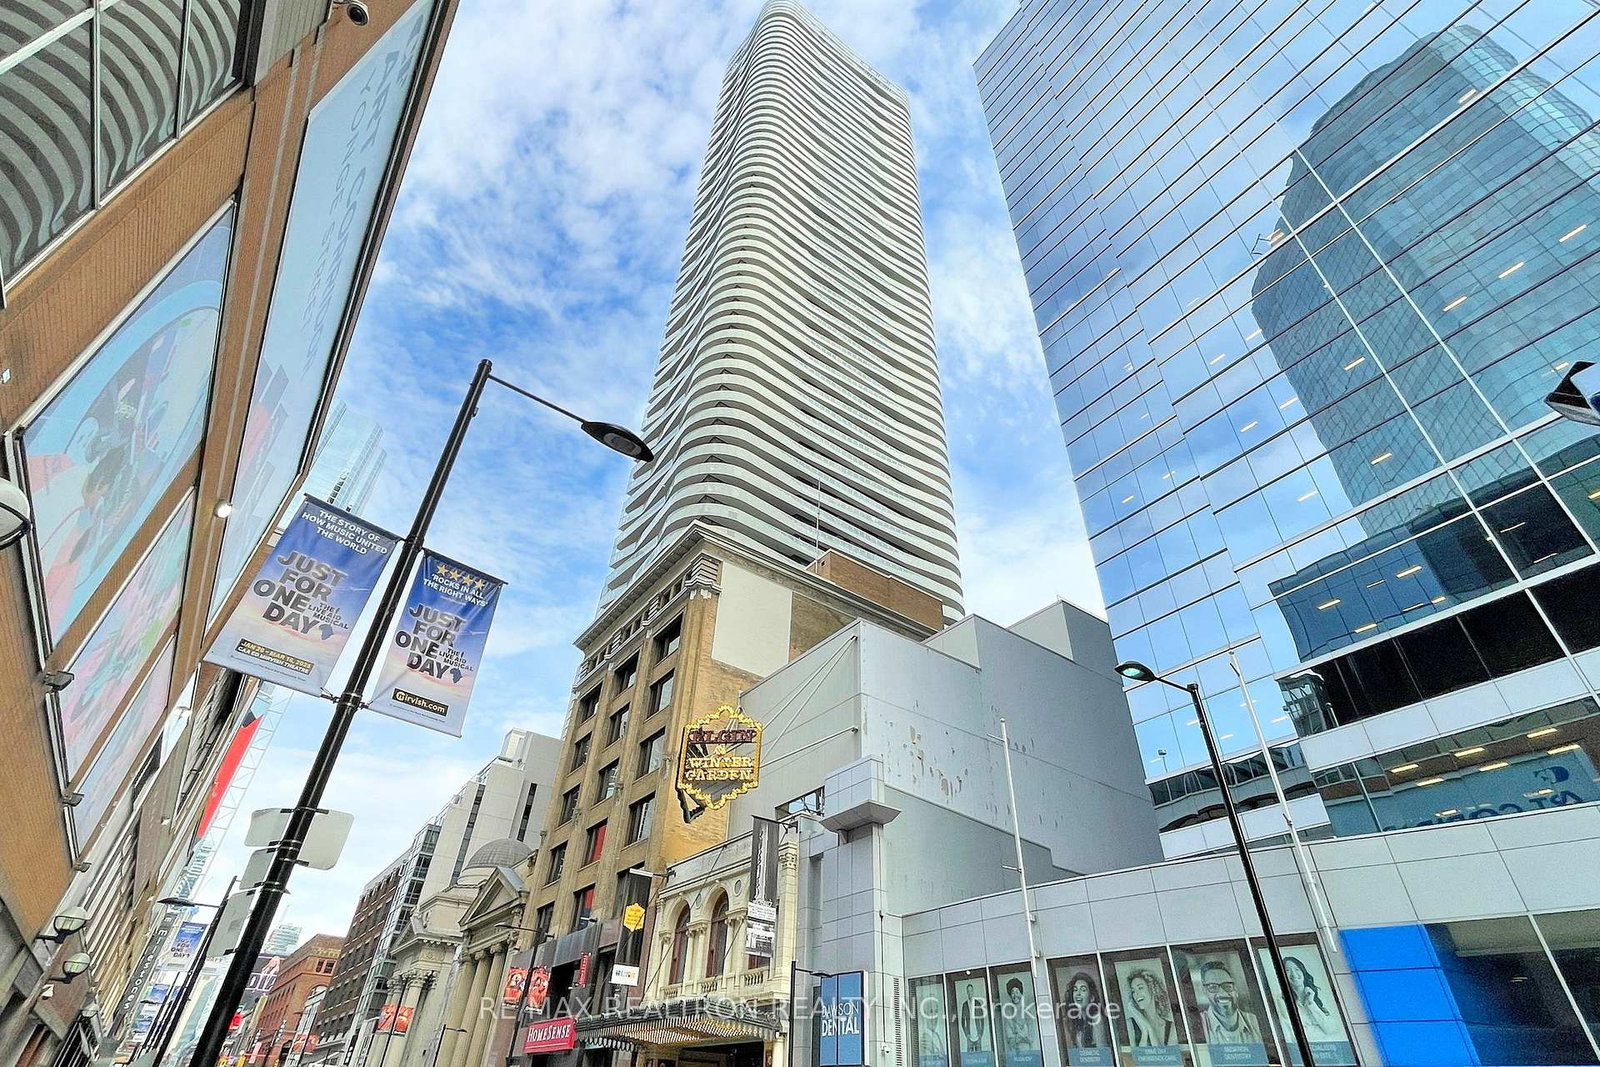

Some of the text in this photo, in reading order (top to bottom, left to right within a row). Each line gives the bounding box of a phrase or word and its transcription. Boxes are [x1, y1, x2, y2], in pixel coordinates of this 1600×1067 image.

[302, 512, 387, 554] HOW MUSIC UNITED
[318, 511, 380, 542] THE STORY OF
[316, 527, 367, 554] THE WORLD
[277, 551, 347, 588] JUST
[280, 569, 332, 601] FOR
[423, 579, 439, 590] THE
[440, 586, 464, 600] RIGHT
[461, 585, 469, 593] IN
[470, 589, 484, 599] ALL
[253, 579, 311, 613] ONE
[308, 605, 341, 621] LIVE AID
[320, 603, 335, 612] THE
[409, 604, 464, 632] JUST
[263, 602, 317, 635] DAY
[313, 611, 349, 630] MUSICAL
[413, 620, 455, 647] FOR
[395, 631, 439, 658] ONE
[448, 647, 460, 656] THE
[407, 652, 449, 679] DAY
[439, 650, 466, 664] LIVE AID
[443, 657, 474, 672] MUSICAL
[284, 662, 310, 674] THEATRE
[690, 730, 755, 742] ELGIN
[686, 757, 754, 768] WINTER
[685, 769, 752, 781] GARDEN
[123, 929, 168, 1009] milestones
[822, 1001, 859, 1019] DAWSON
[822, 1016, 860, 1037] DENTAL
